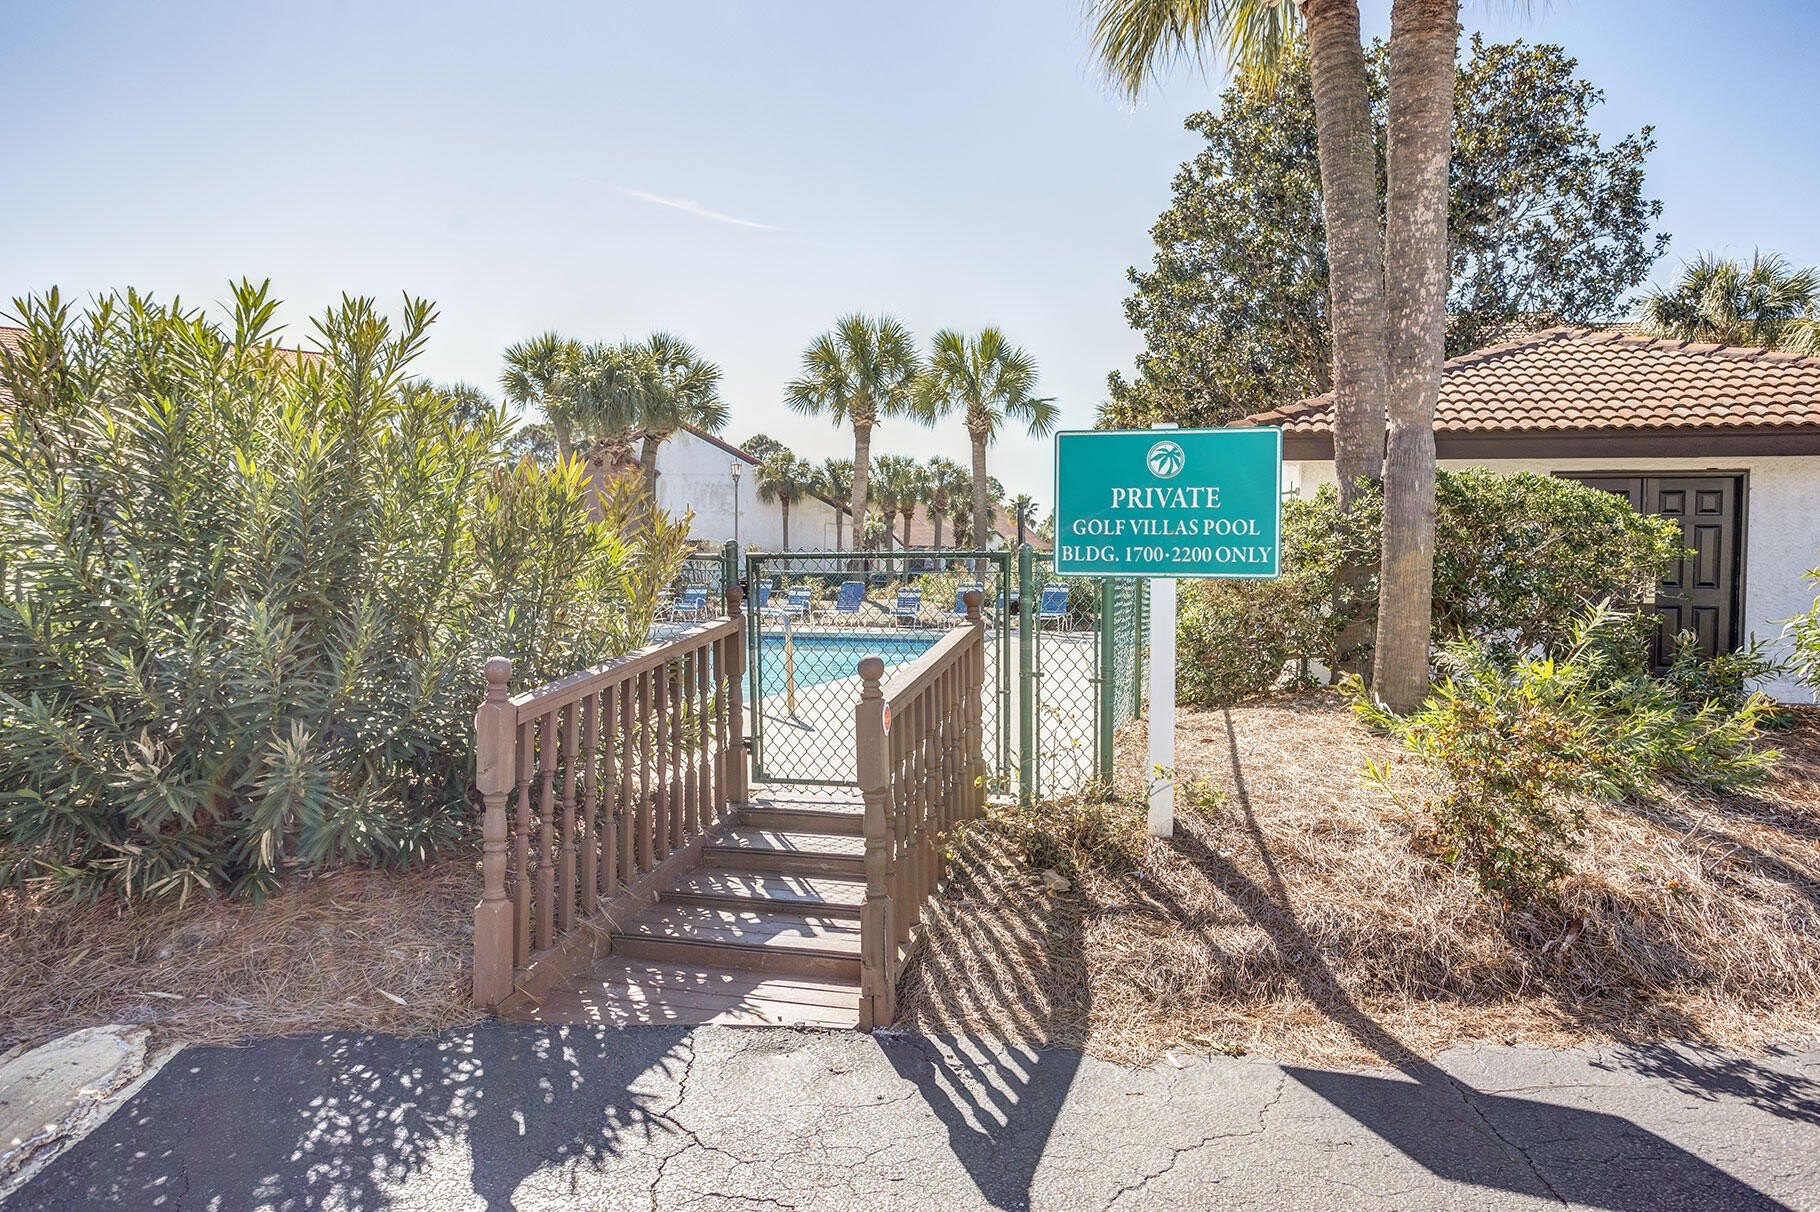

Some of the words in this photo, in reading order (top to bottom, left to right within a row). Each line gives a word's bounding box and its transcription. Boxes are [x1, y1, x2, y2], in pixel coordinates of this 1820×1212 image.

[1110, 487, 1221, 509] PRIVATE
[1072, 519, 1126, 536] GOLF
[1129, 519, 1199, 536] VILLAS
[1203, 519, 1261, 536] POOL
[1061, 545, 1120, 562] BLDG.
[1215, 546, 1273, 563] ONLY
